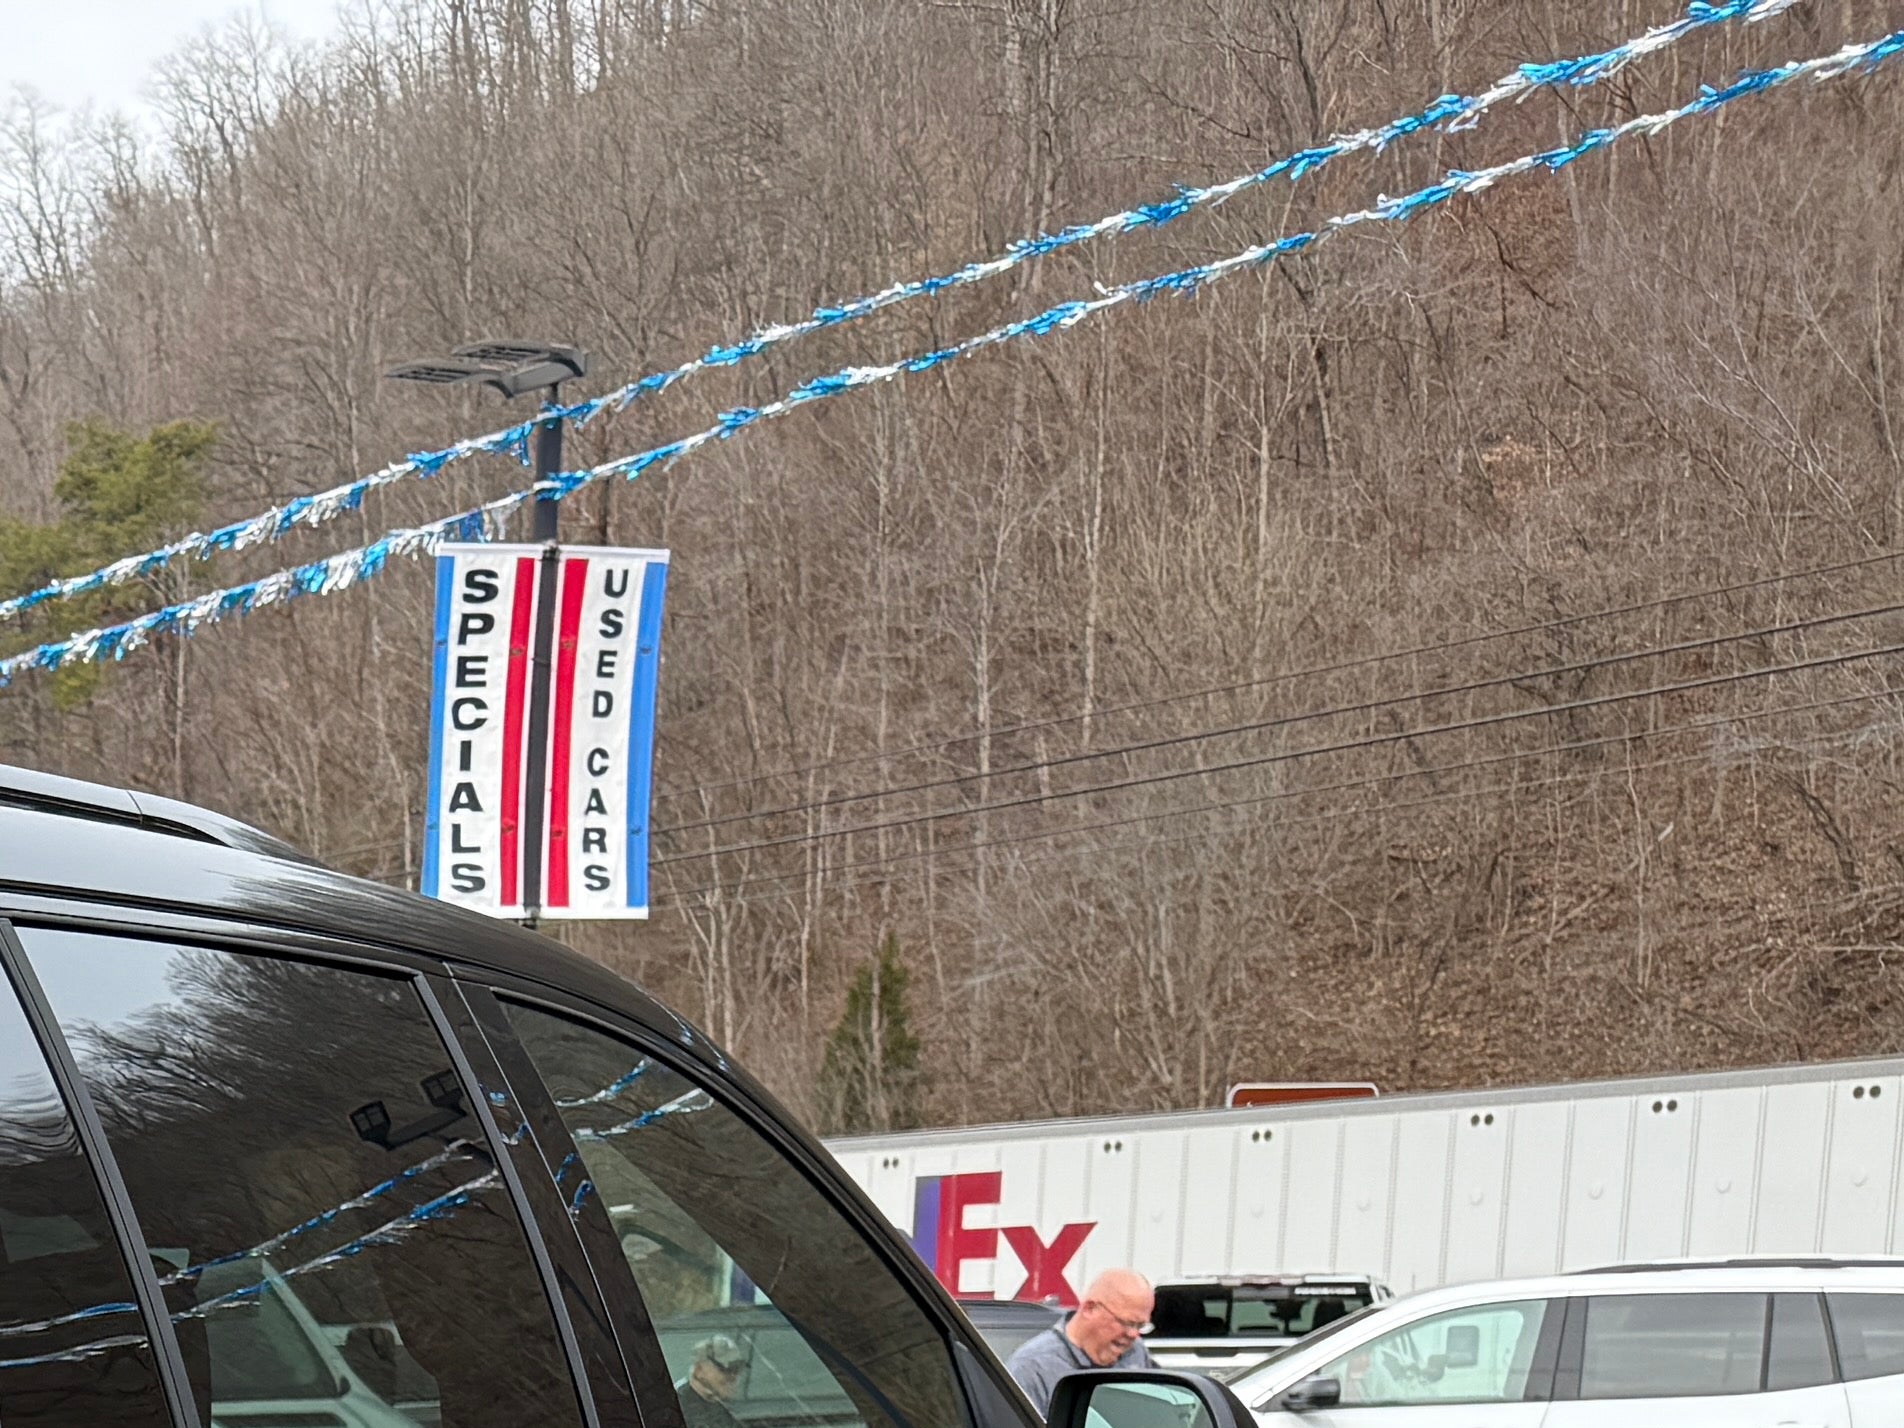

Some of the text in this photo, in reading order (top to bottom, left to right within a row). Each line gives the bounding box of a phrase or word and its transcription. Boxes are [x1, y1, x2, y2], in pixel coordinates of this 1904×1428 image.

[448, 568, 499, 894] SPECIALS
[581, 568, 629, 892] USED CARS
[913, 1171, 1098, 1308] Ex
